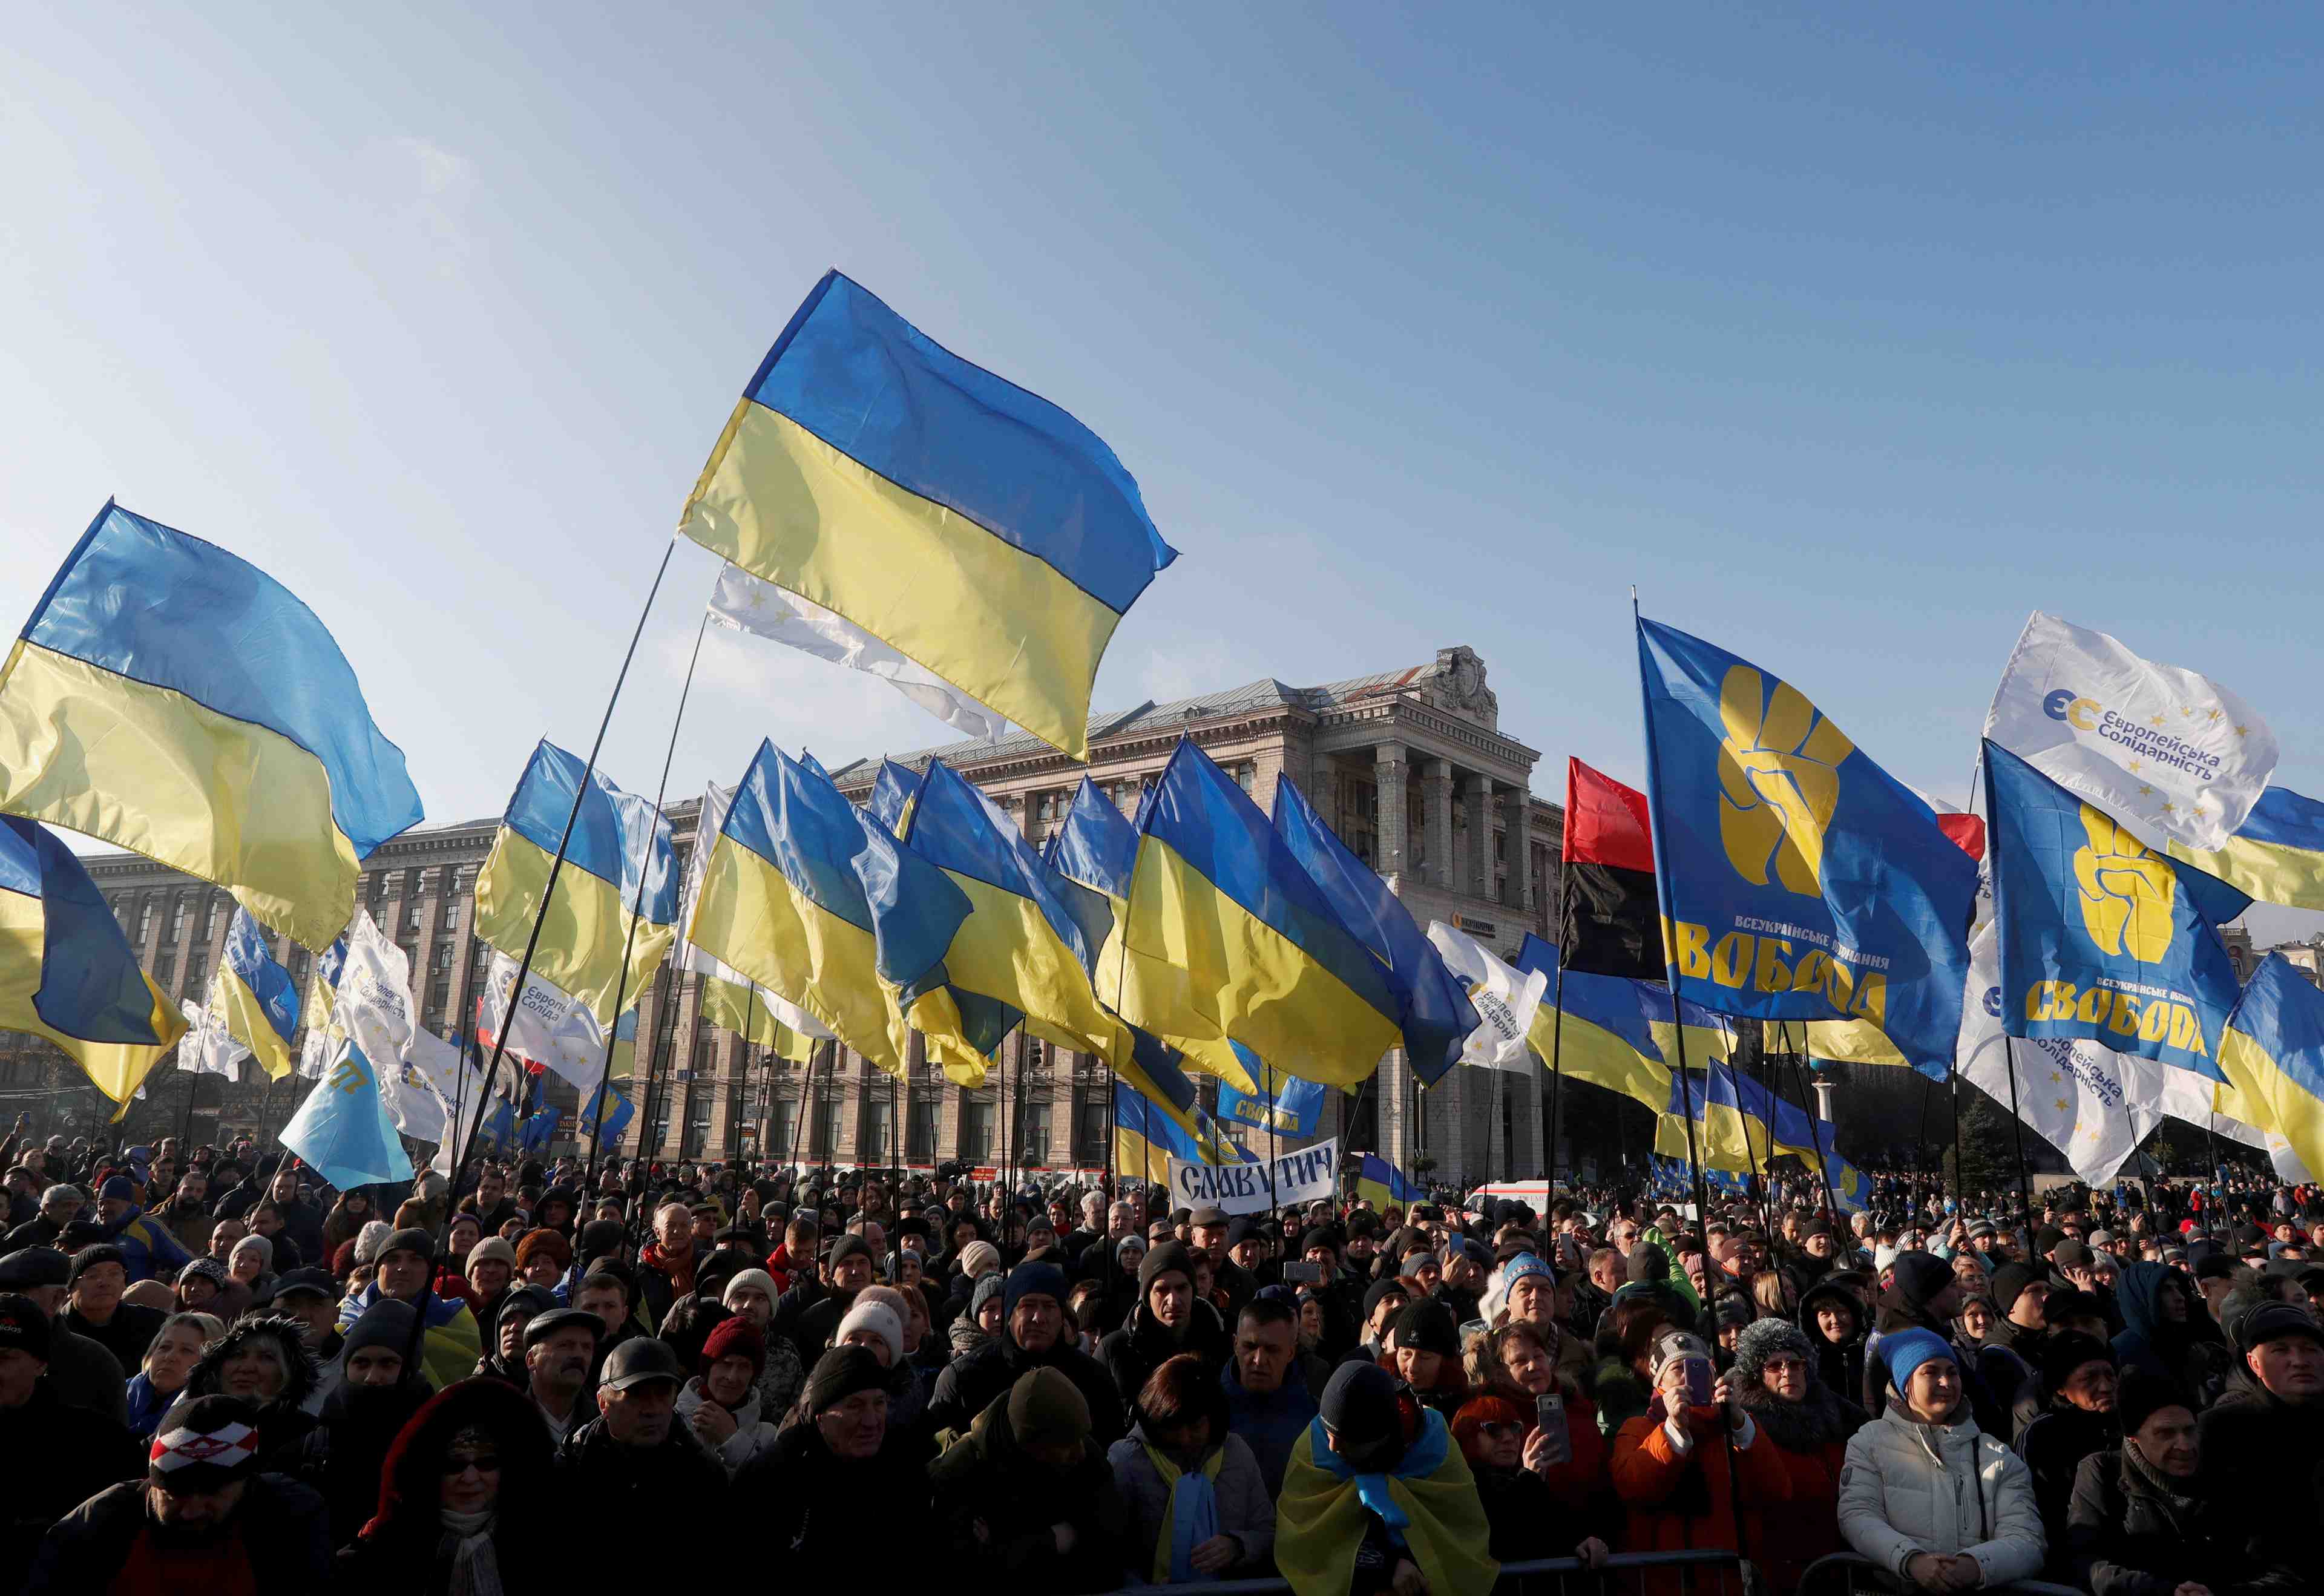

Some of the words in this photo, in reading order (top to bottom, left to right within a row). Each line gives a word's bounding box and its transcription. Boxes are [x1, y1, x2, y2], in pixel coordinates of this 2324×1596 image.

[2098, 723, 2213, 781] Солідарність
[2104, 711, 2221, 767] Європейська
[1735, 915, 1830, 947] ВСЕУКРАЇНСЬКЕ
[2096, 977, 2168, 999] ВСЕУКРАЇНСЬКЕ
